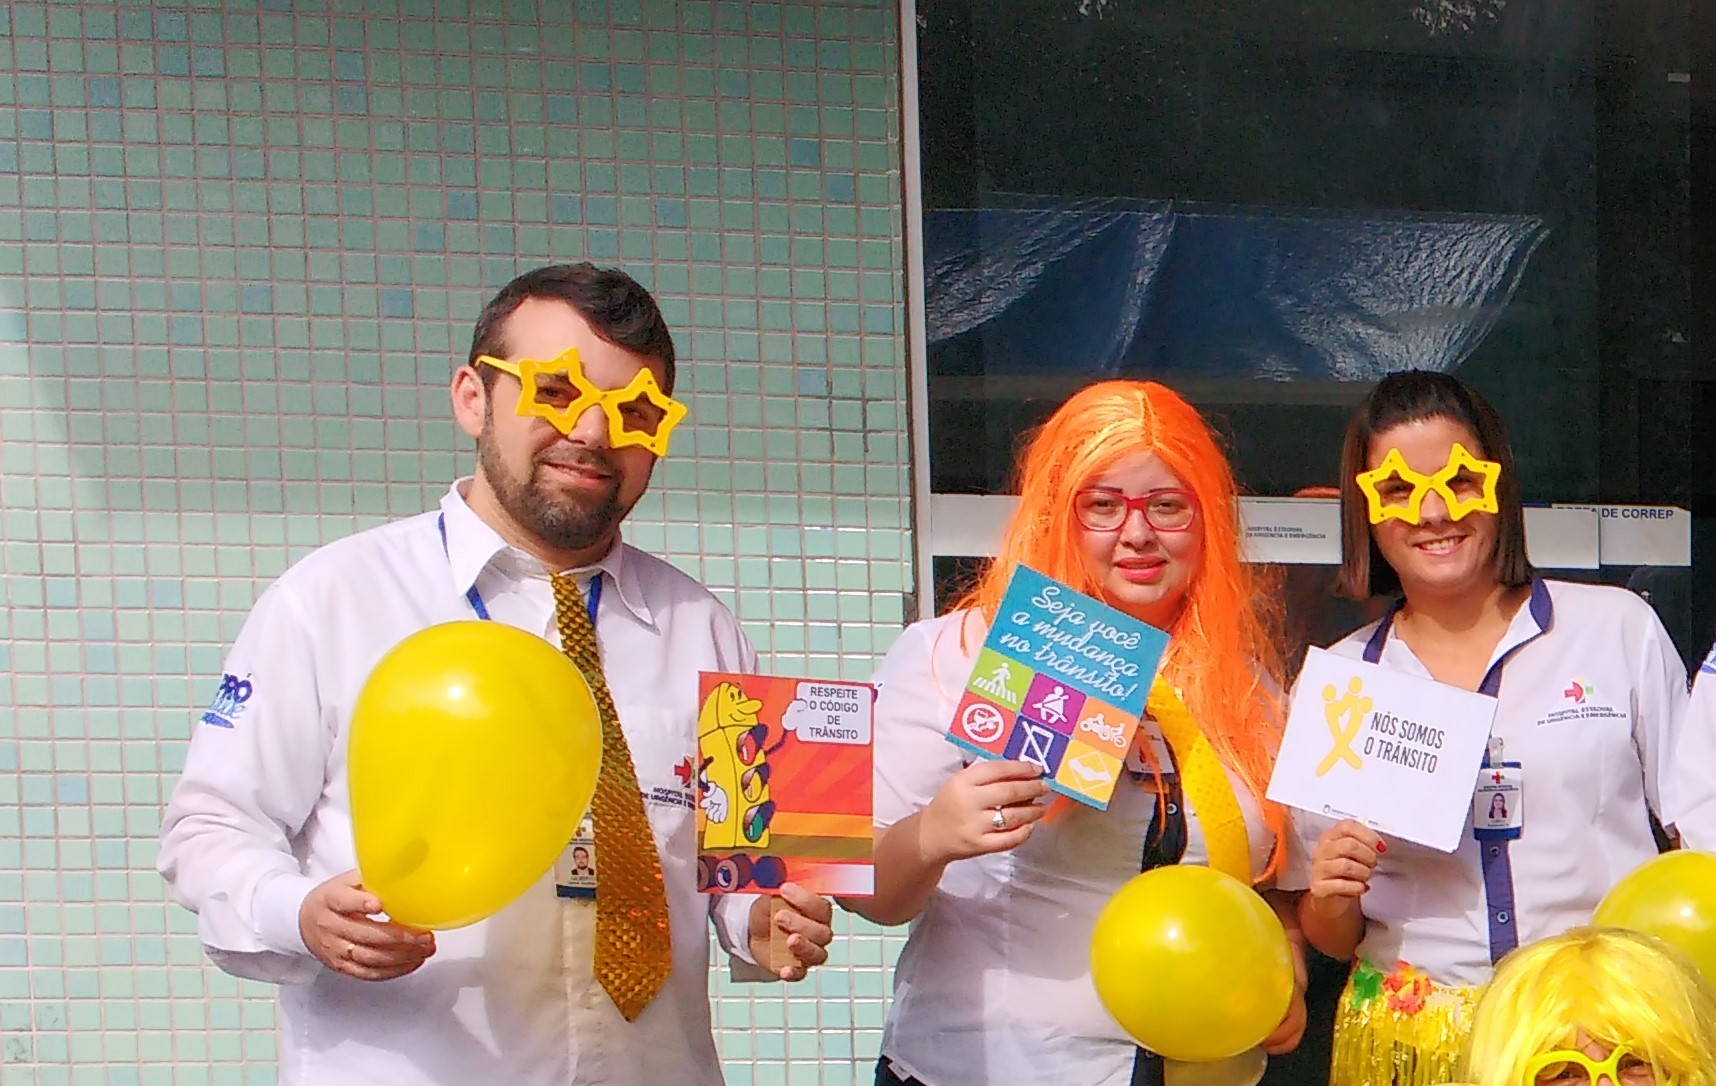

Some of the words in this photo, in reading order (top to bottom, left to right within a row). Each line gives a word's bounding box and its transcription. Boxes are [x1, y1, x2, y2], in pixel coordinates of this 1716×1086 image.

[1601, 508, 1618, 519] DE
[1031, 586, 1086, 625] Seja
[1089, 621, 1141, 649] você
[1011, 611, 1031, 625] a
[1032, 621, 1139, 677] mudança
[1000, 633, 1031, 652] no
[1034, 641, 1138, 701] trânsito!
[810, 686, 858, 699] RESPEITE
[809, 700, 817, 710] O
[819, 699, 859, 713] CÓDIGO
[827, 715, 841, 725] DE
[1370, 711, 1399, 736] NÓS
[1399, 720, 1445, 749] SOMOS
[809, 726, 858, 740] TRÂNSITO
[1363, 736, 1375, 755] O
[1377, 739, 1438, 773] TRÂNSITO
